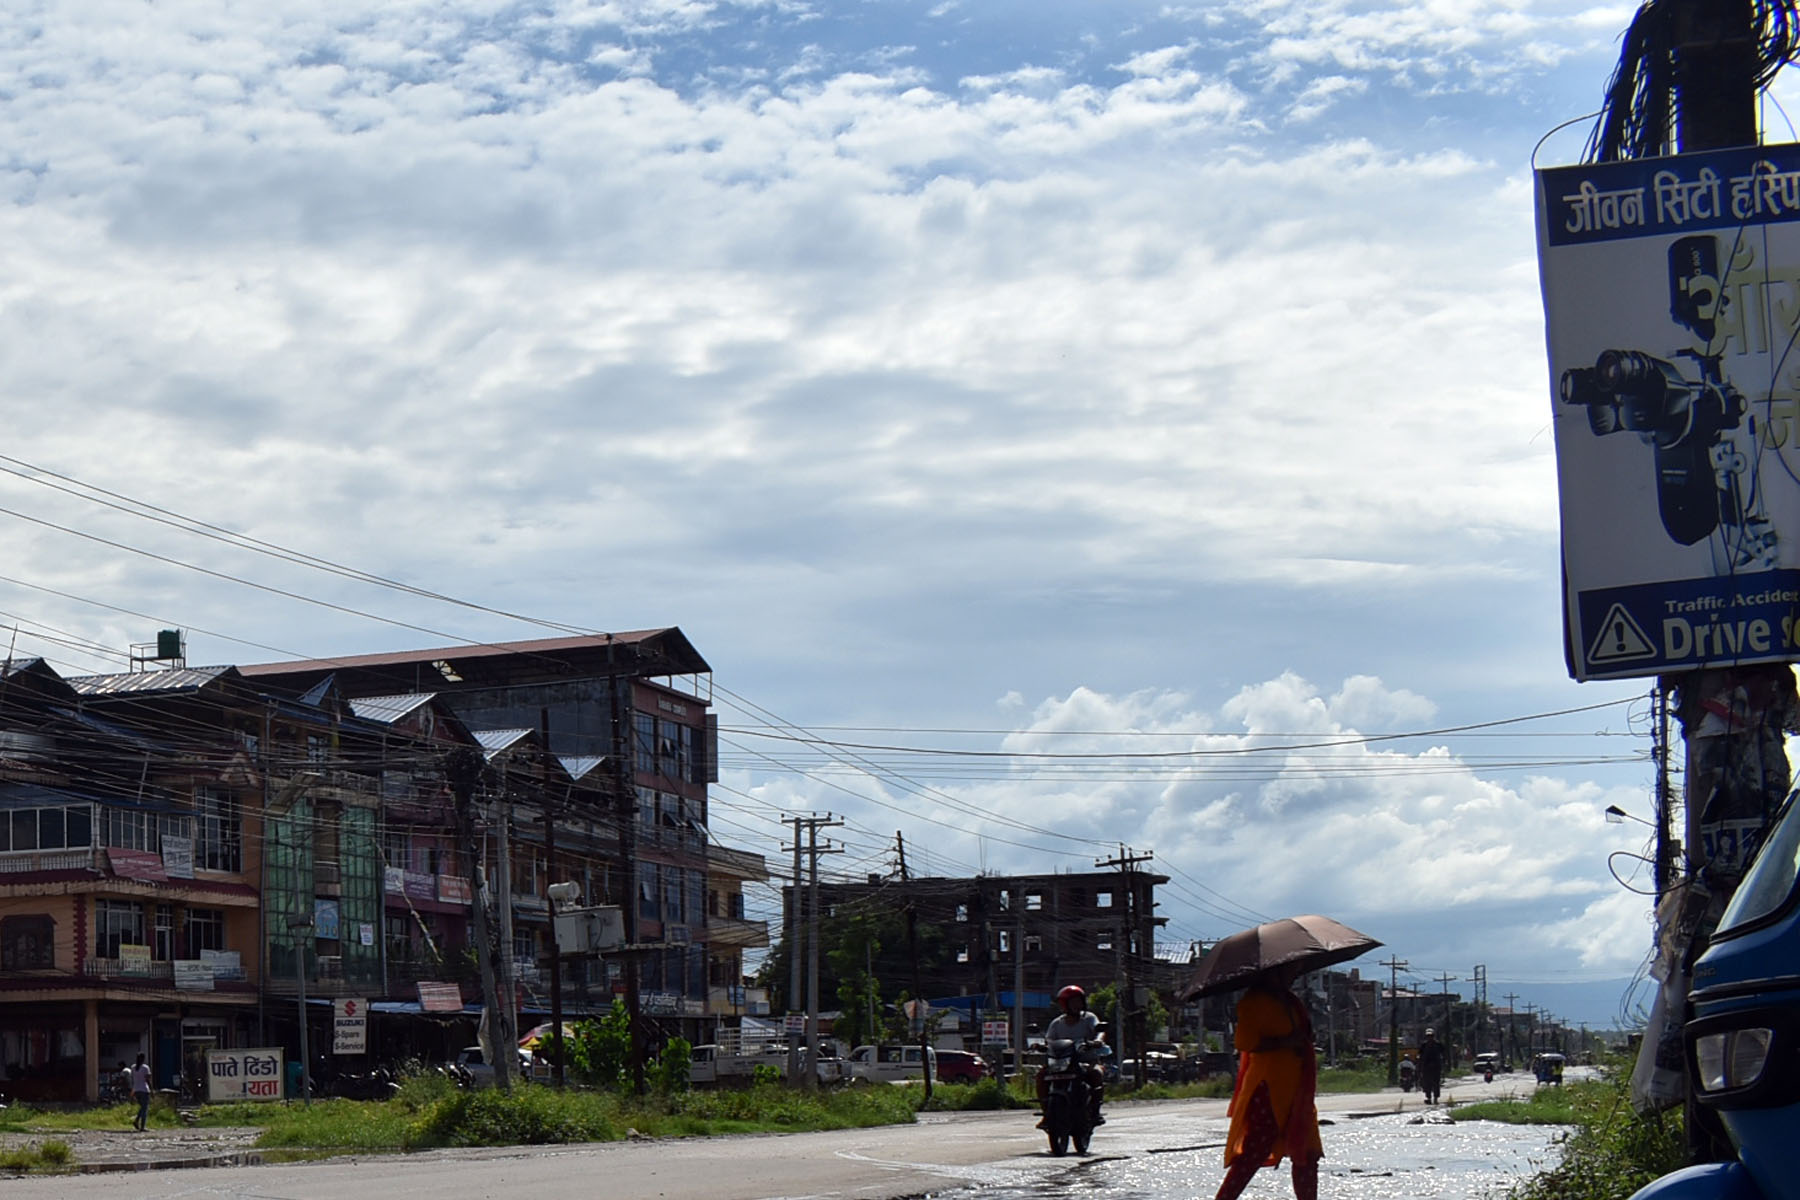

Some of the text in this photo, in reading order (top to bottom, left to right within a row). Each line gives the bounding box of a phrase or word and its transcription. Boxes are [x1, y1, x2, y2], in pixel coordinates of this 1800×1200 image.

[1563, 180, 1645, 233] जीवन
[1653, 167, 1721, 225] सिटी
[1663, 612, 1770, 660] Drive
[336, 1019, 364, 1027] SUZUKI
[211, 1057, 239, 1077] पाते
[248, 1080, 278, 1096] यता
